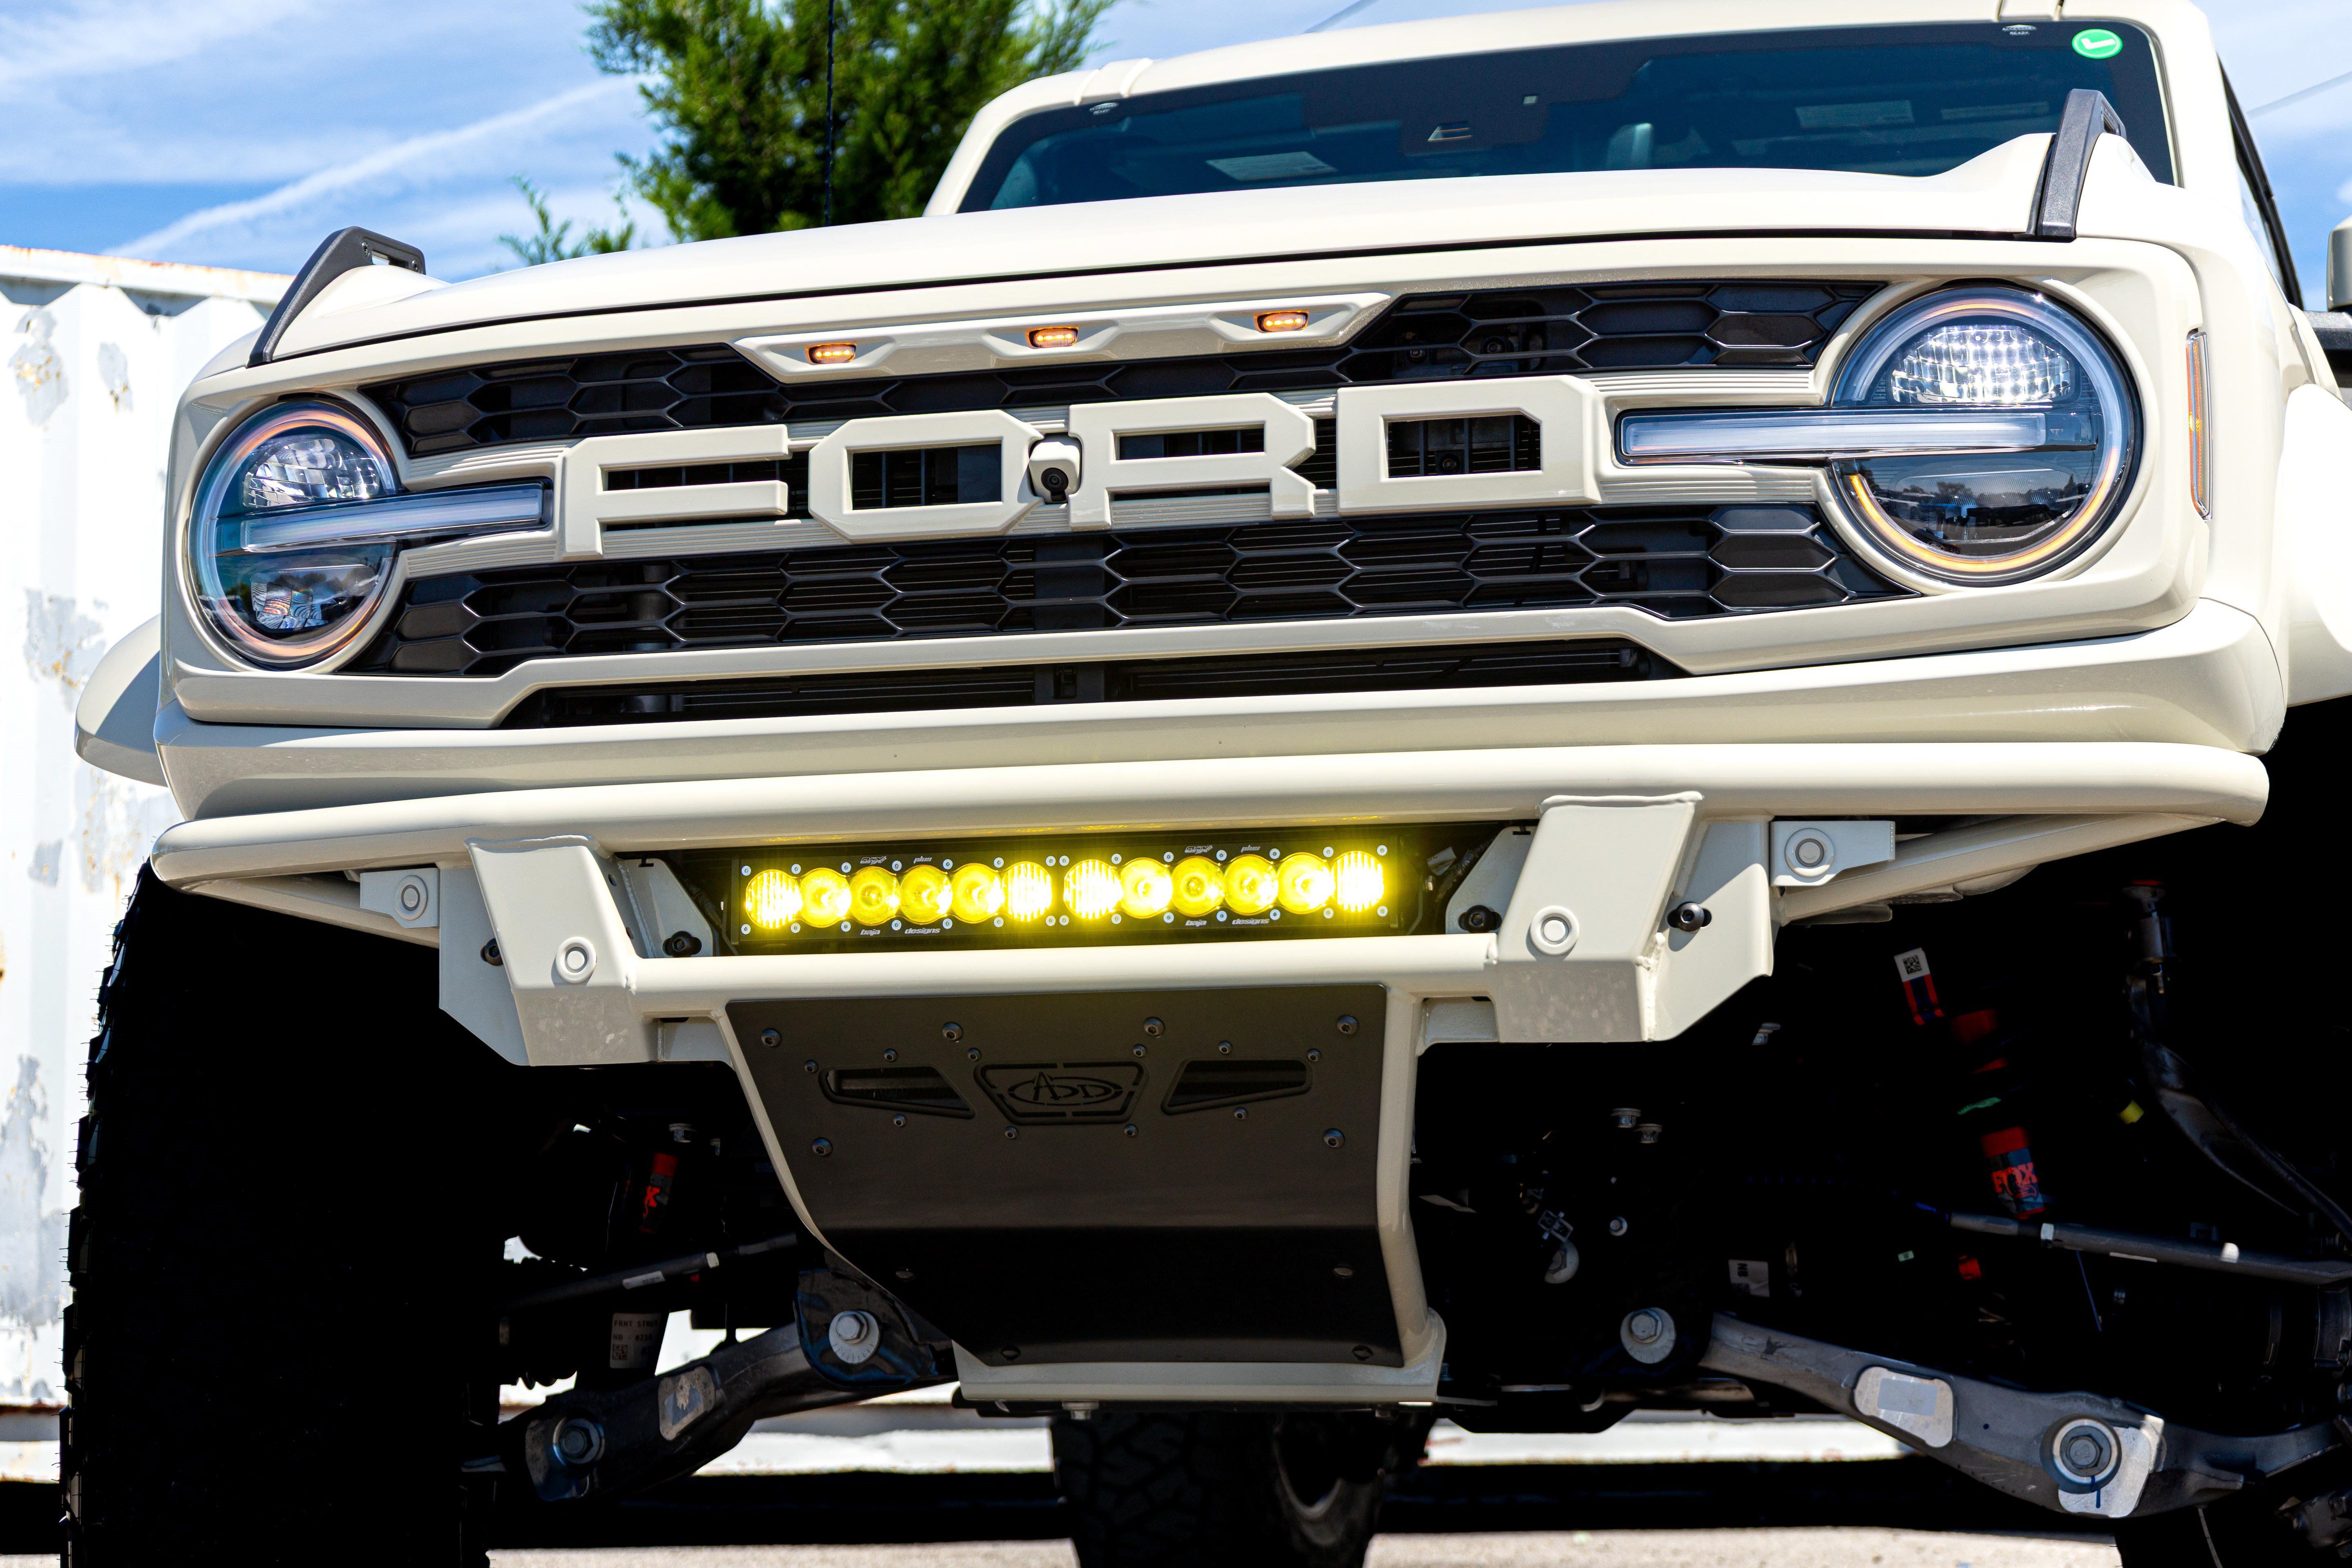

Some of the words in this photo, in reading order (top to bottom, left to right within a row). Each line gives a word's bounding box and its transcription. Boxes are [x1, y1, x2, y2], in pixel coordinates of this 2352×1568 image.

[558, 374, 1603, 559] FORD
[913, 855, 932, 864] plus
[1241, 844, 1261, 853] plus
[1991, 1162, 2038, 1198] FOX
